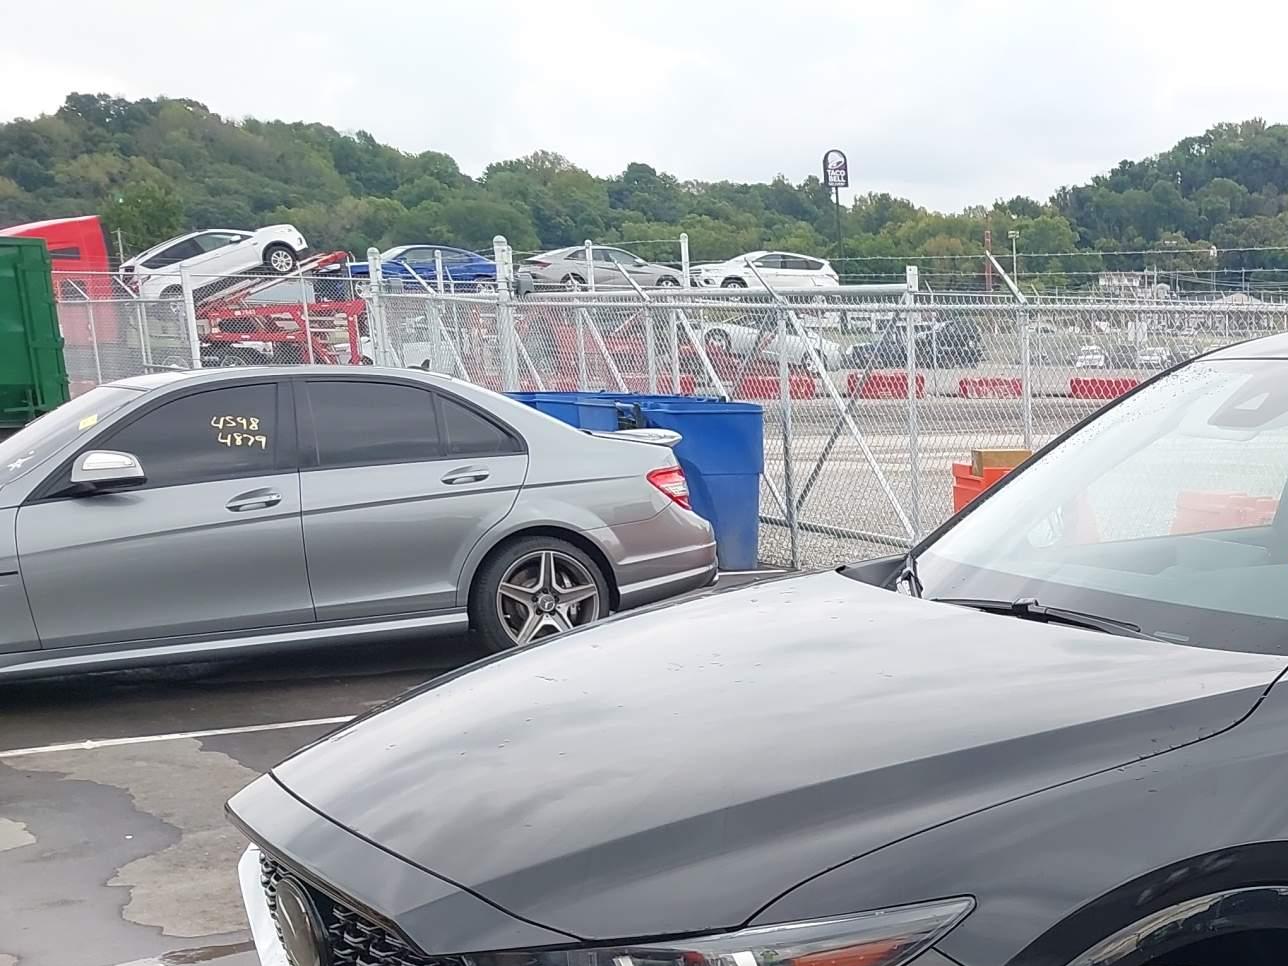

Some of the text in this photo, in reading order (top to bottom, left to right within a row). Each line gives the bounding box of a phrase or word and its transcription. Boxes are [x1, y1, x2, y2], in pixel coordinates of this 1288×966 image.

[827, 169, 846, 177] TACO
[828, 175, 846, 183] BELL
[211, 415, 260, 431] 4598
[217, 432, 267, 450] 4879
